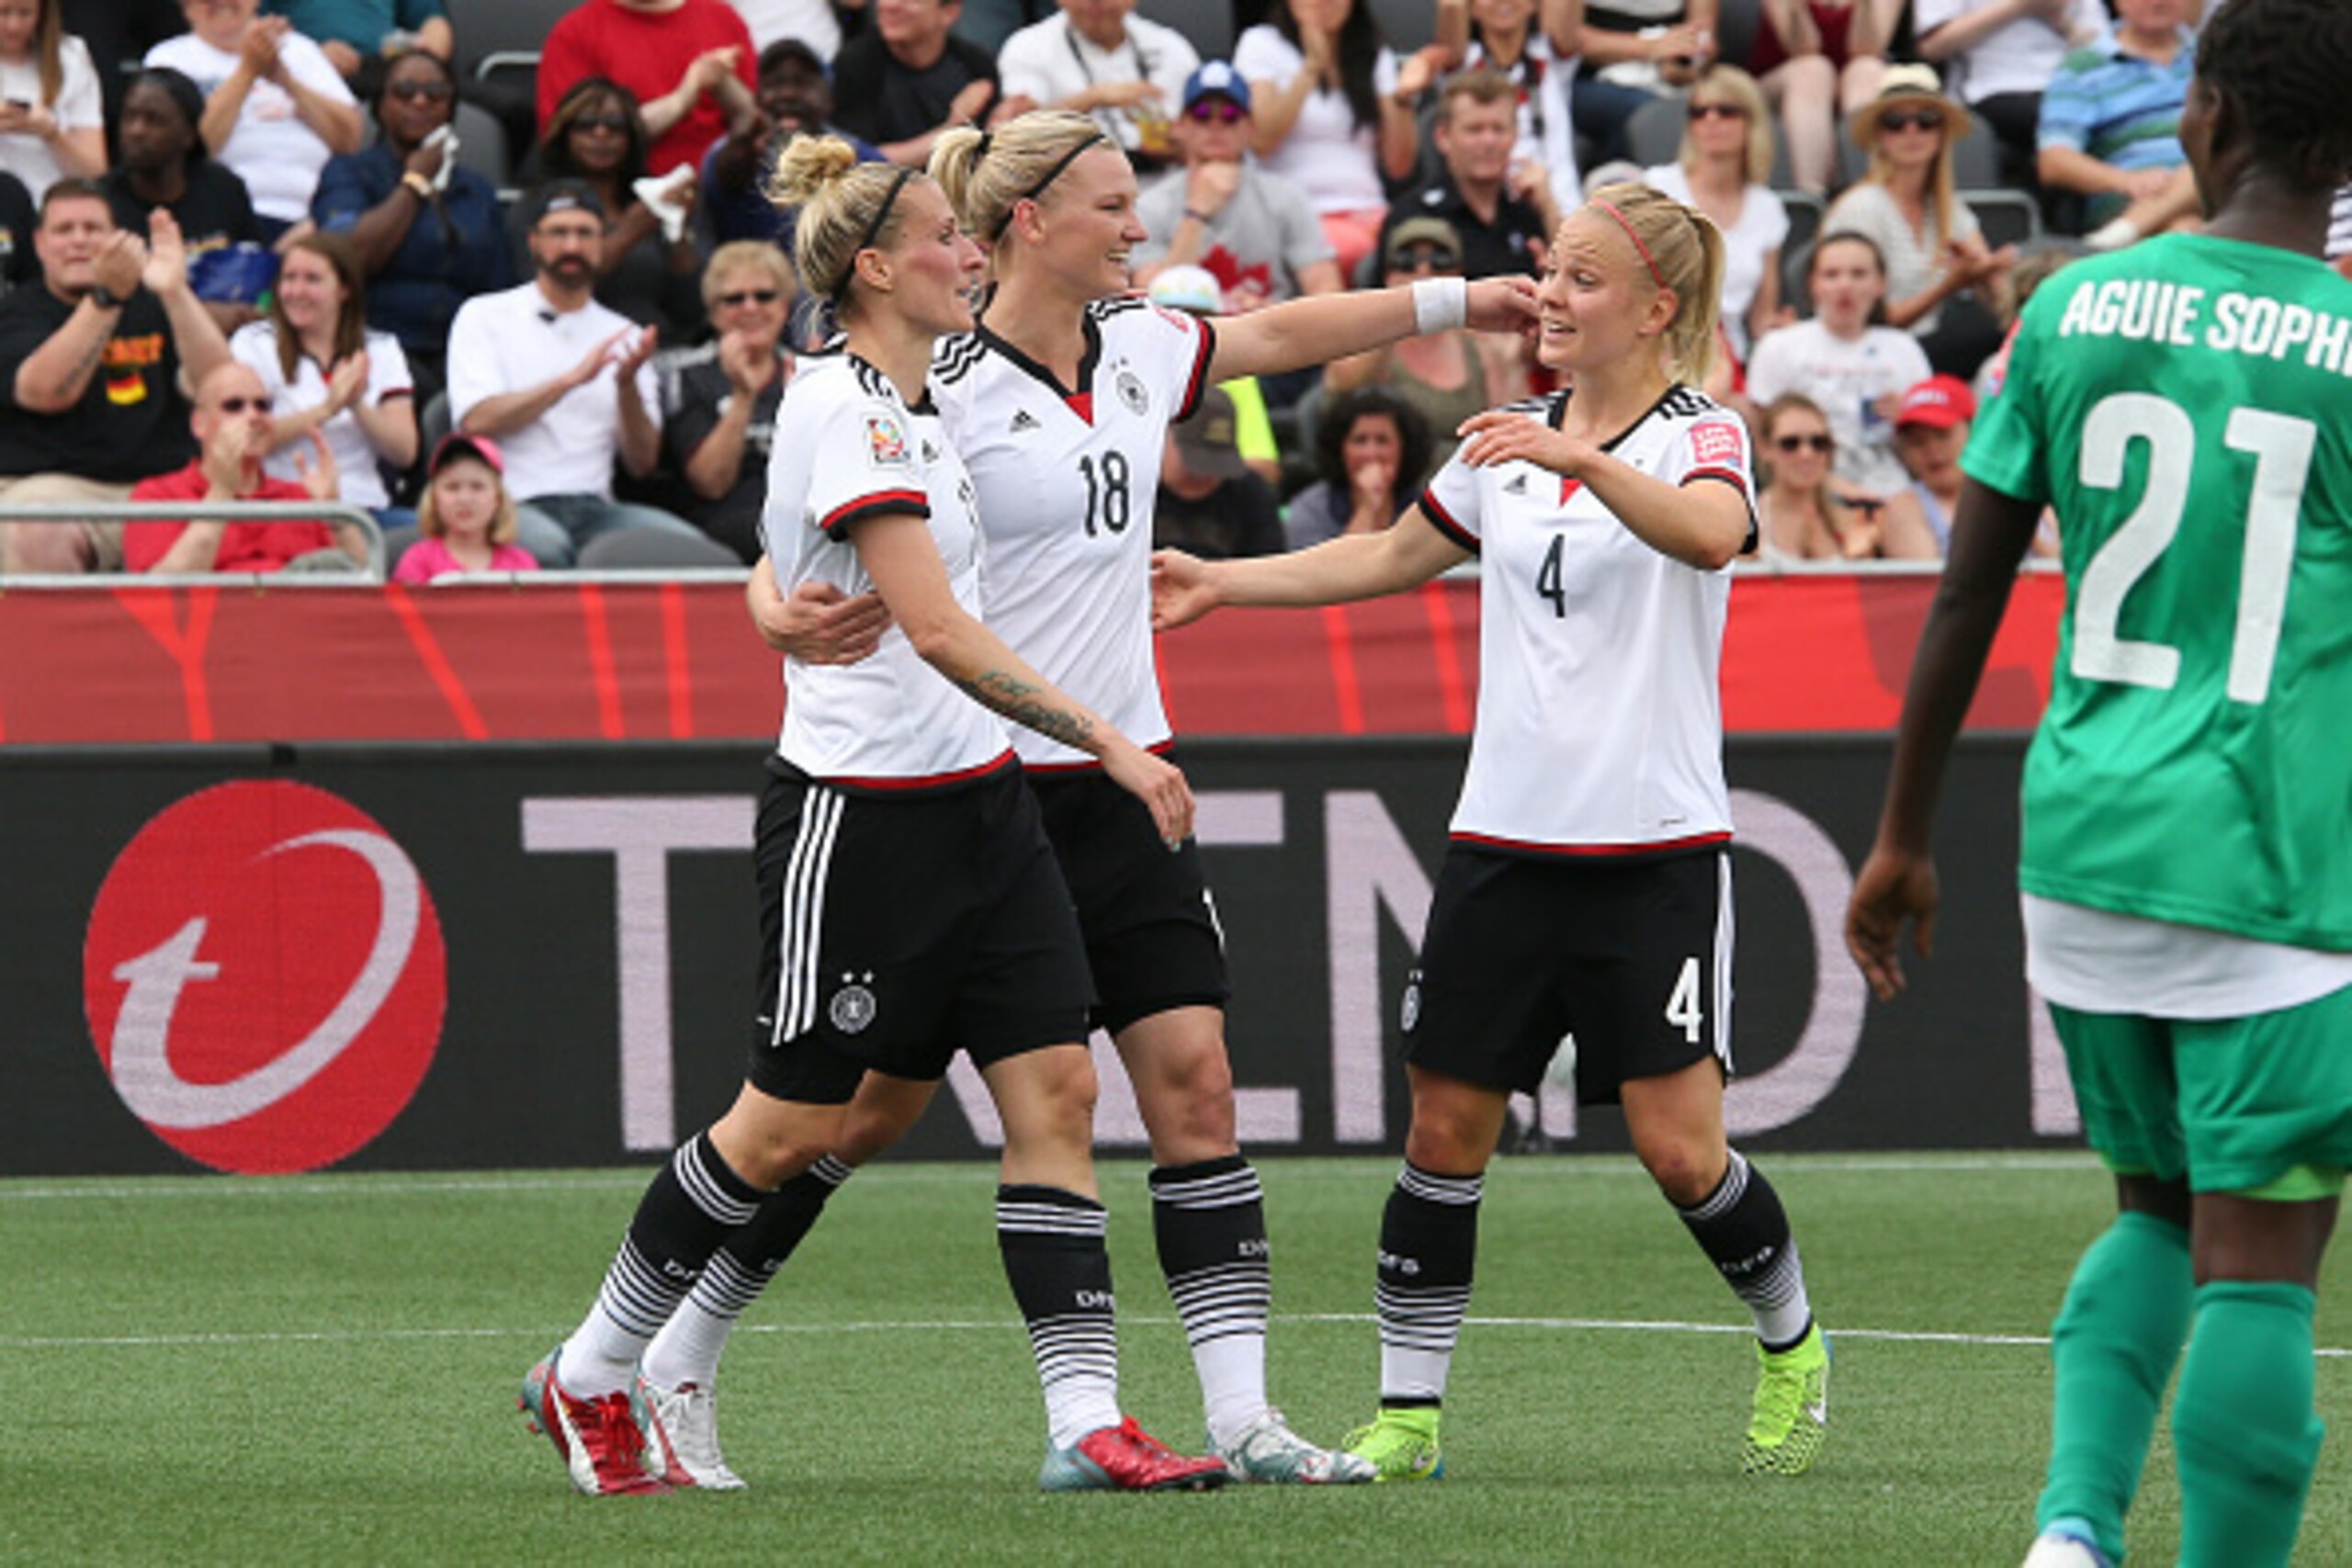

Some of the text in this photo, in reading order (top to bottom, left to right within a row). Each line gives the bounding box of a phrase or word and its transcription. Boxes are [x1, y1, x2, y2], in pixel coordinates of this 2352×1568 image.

[2059, 279, 2205, 345] AGUIE
[1079, 450, 1129, 537] 18
[1536, 534, 1566, 618] 4
[2071, 391, 2317, 705] 21
[1665, 957, 1702, 1043] 4
